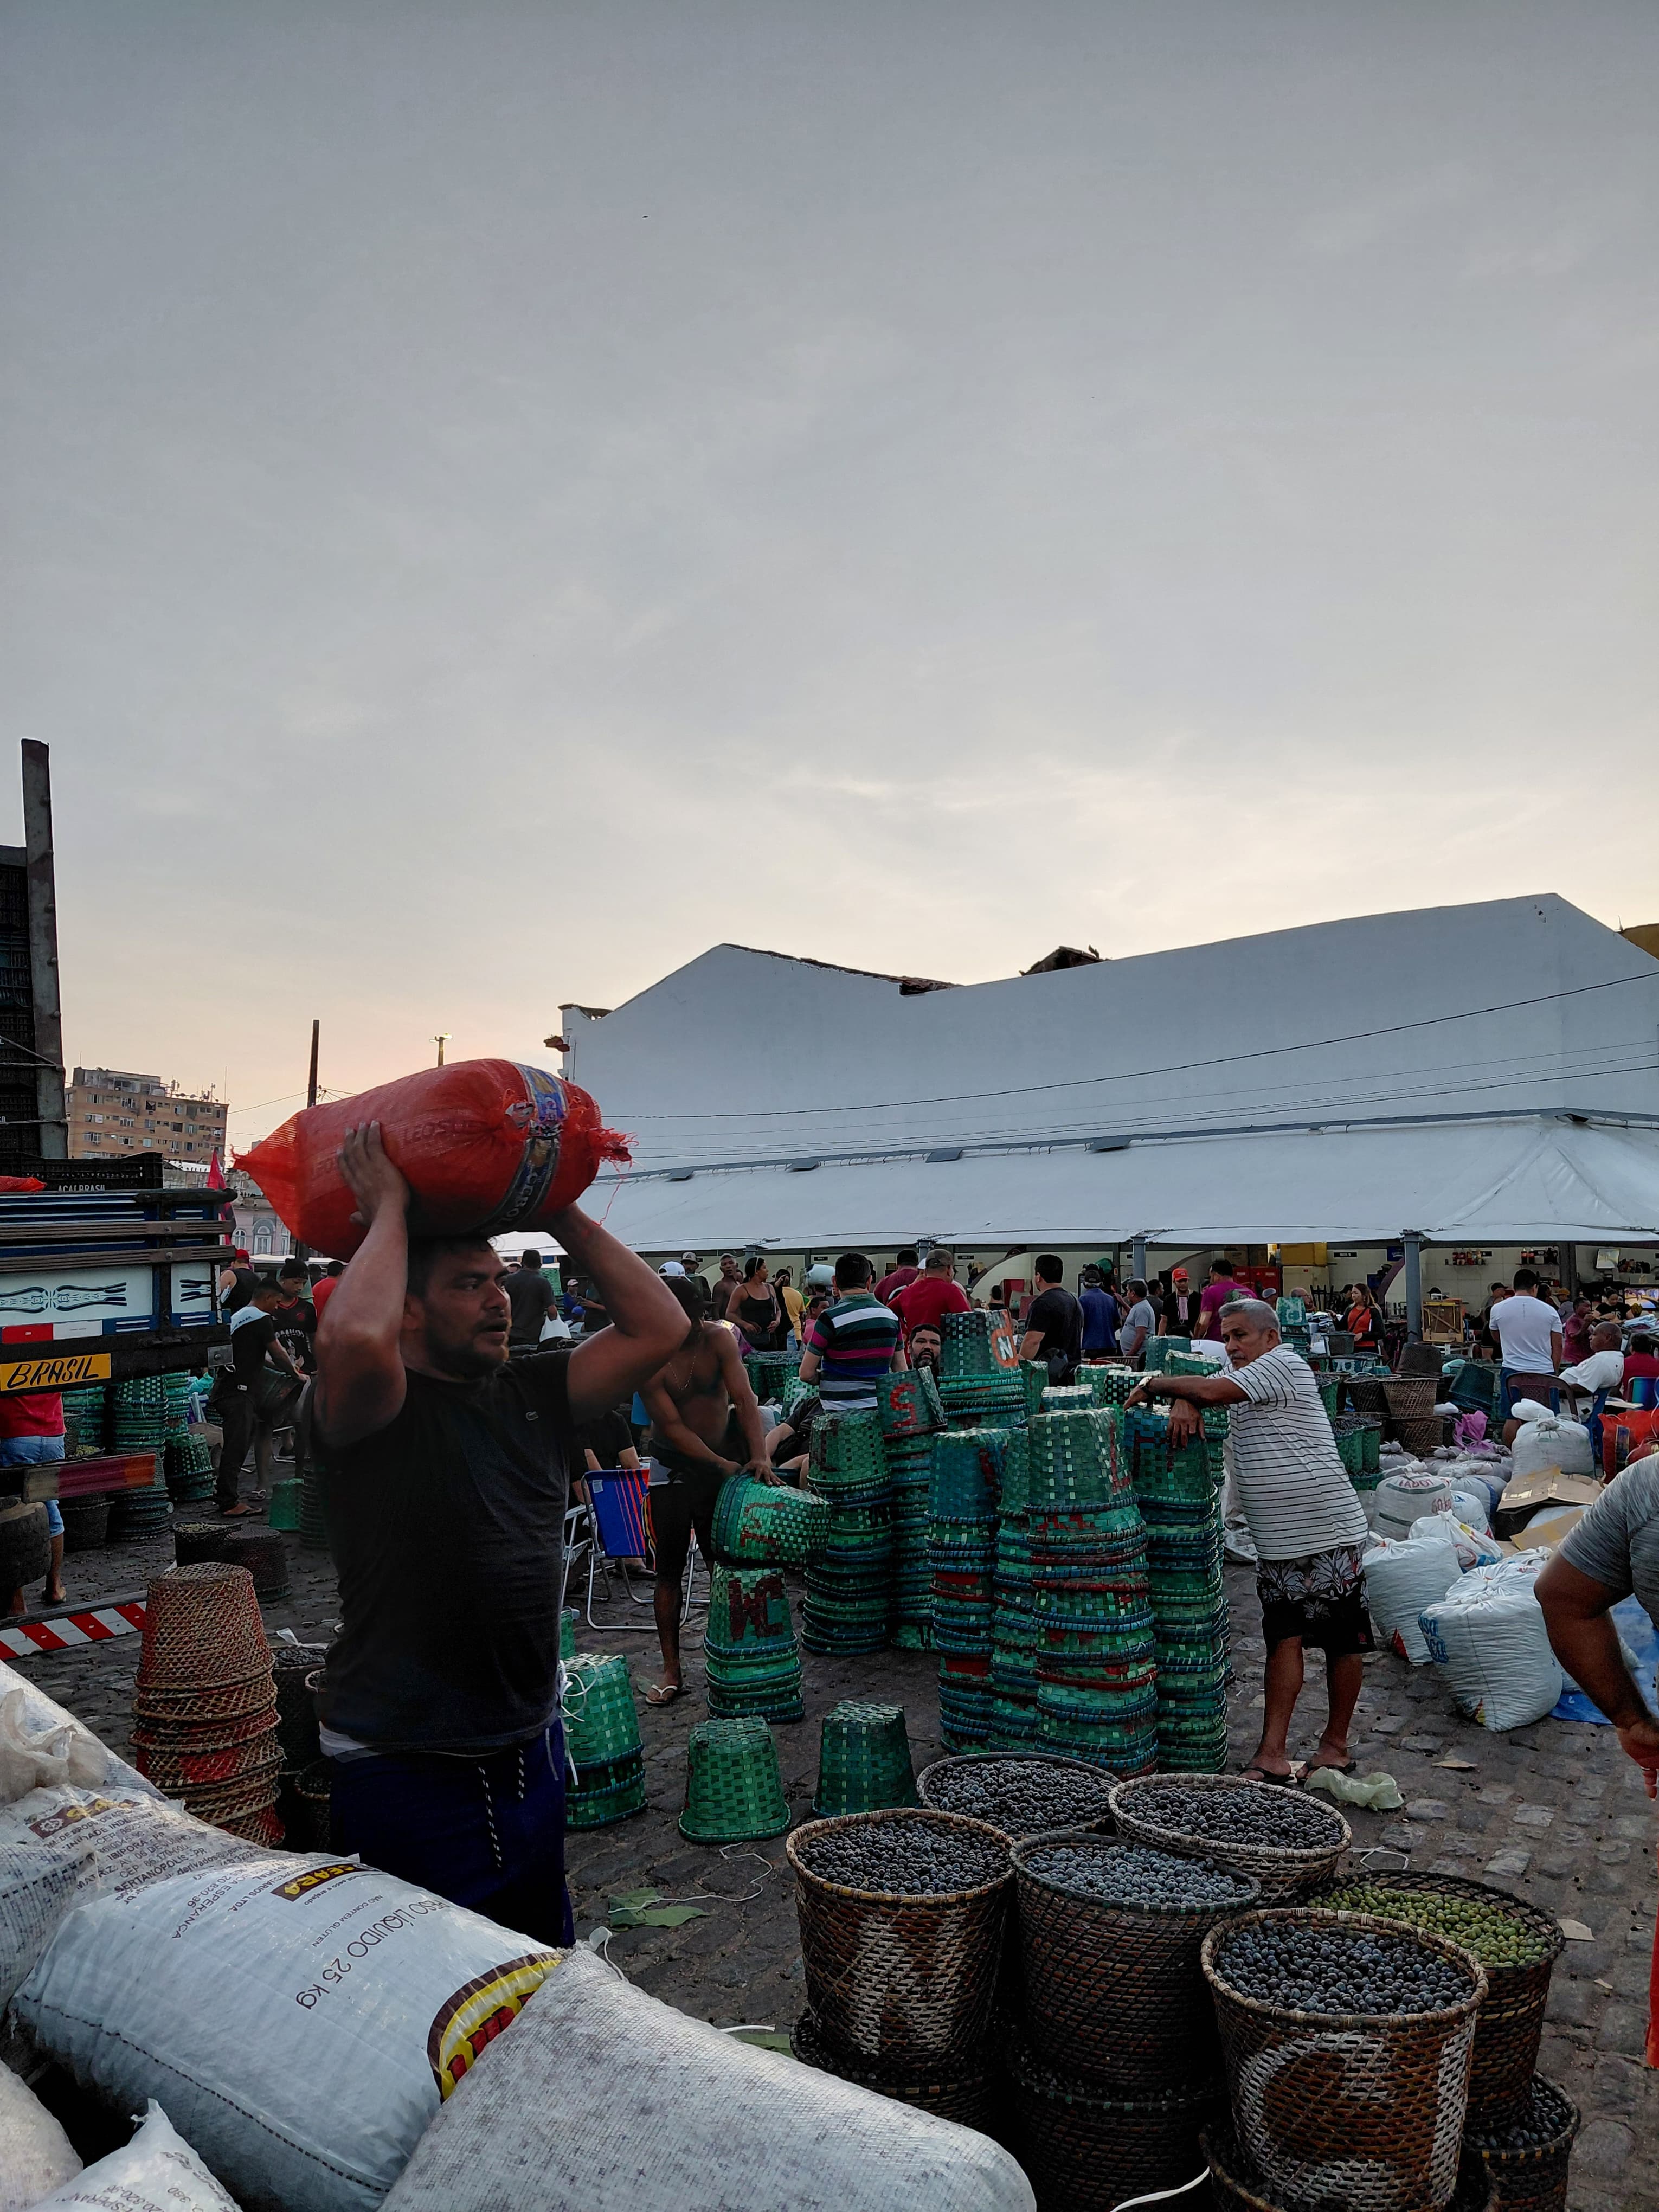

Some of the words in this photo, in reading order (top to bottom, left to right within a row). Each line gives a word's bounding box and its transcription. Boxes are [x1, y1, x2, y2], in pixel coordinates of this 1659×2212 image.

[7, 1356, 99, 1388] BRASIL
[134, 1850, 148, 1861] 06
[114, 1853, 189, 1893] SERTANÓPOLIS
[192, 1847, 208, 1857] PR
[171, 1884, 233, 1939] ESPERANÇA
[339, 1902, 369, 1922] CONTÉM
[312, 1921, 341, 1947] GLÚTEN
[347, 1908, 416, 1958] LÍQUIDO
[321, 1957, 352, 1985] 25
[295, 1983, 330, 2010] kg
